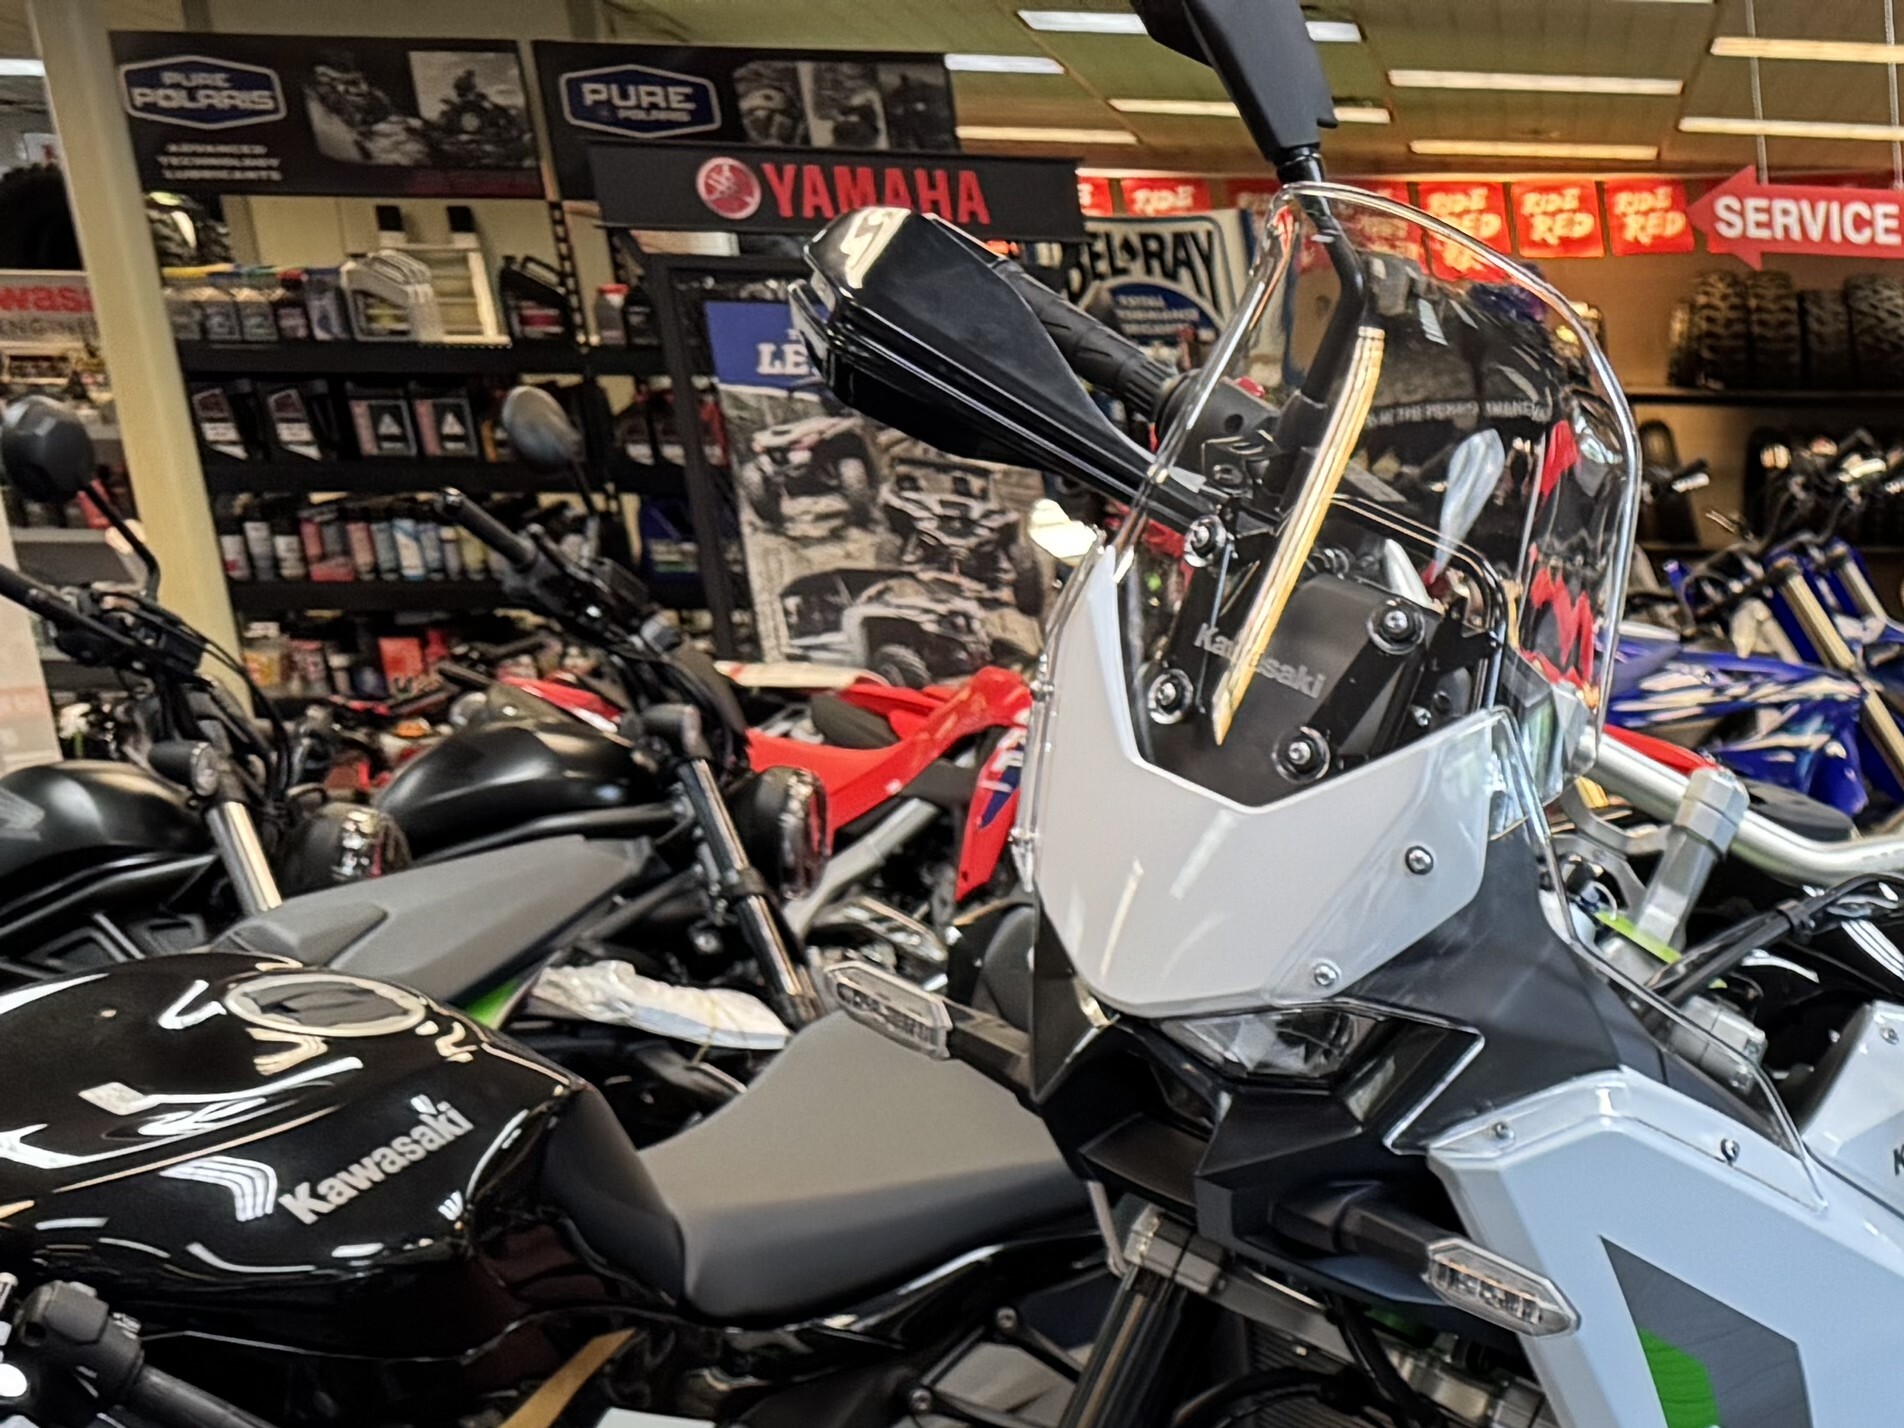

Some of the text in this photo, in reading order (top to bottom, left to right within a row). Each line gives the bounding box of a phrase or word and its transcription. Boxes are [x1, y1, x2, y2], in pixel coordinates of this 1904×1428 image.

[160, 71, 230, 89] PURE
[582, 82, 696, 109] PURE
[133, 87, 276, 110] POLARIS
[761, 163, 991, 225] YAMAHA
[1427, 187, 1489, 217] RIDE
[1520, 187, 1581, 216] RIDE
[1613, 185, 1673, 214] RIDE
[1530, 211, 1595, 246] RED
[1622, 210, 1687, 245] RED
[1713, 195, 1902, 246] SERVICE
[1139, 231, 1225, 318] RAY
[1193, 622, 1326, 699] Kasaki
[278, 1099, 475, 1226] Kawasaki
